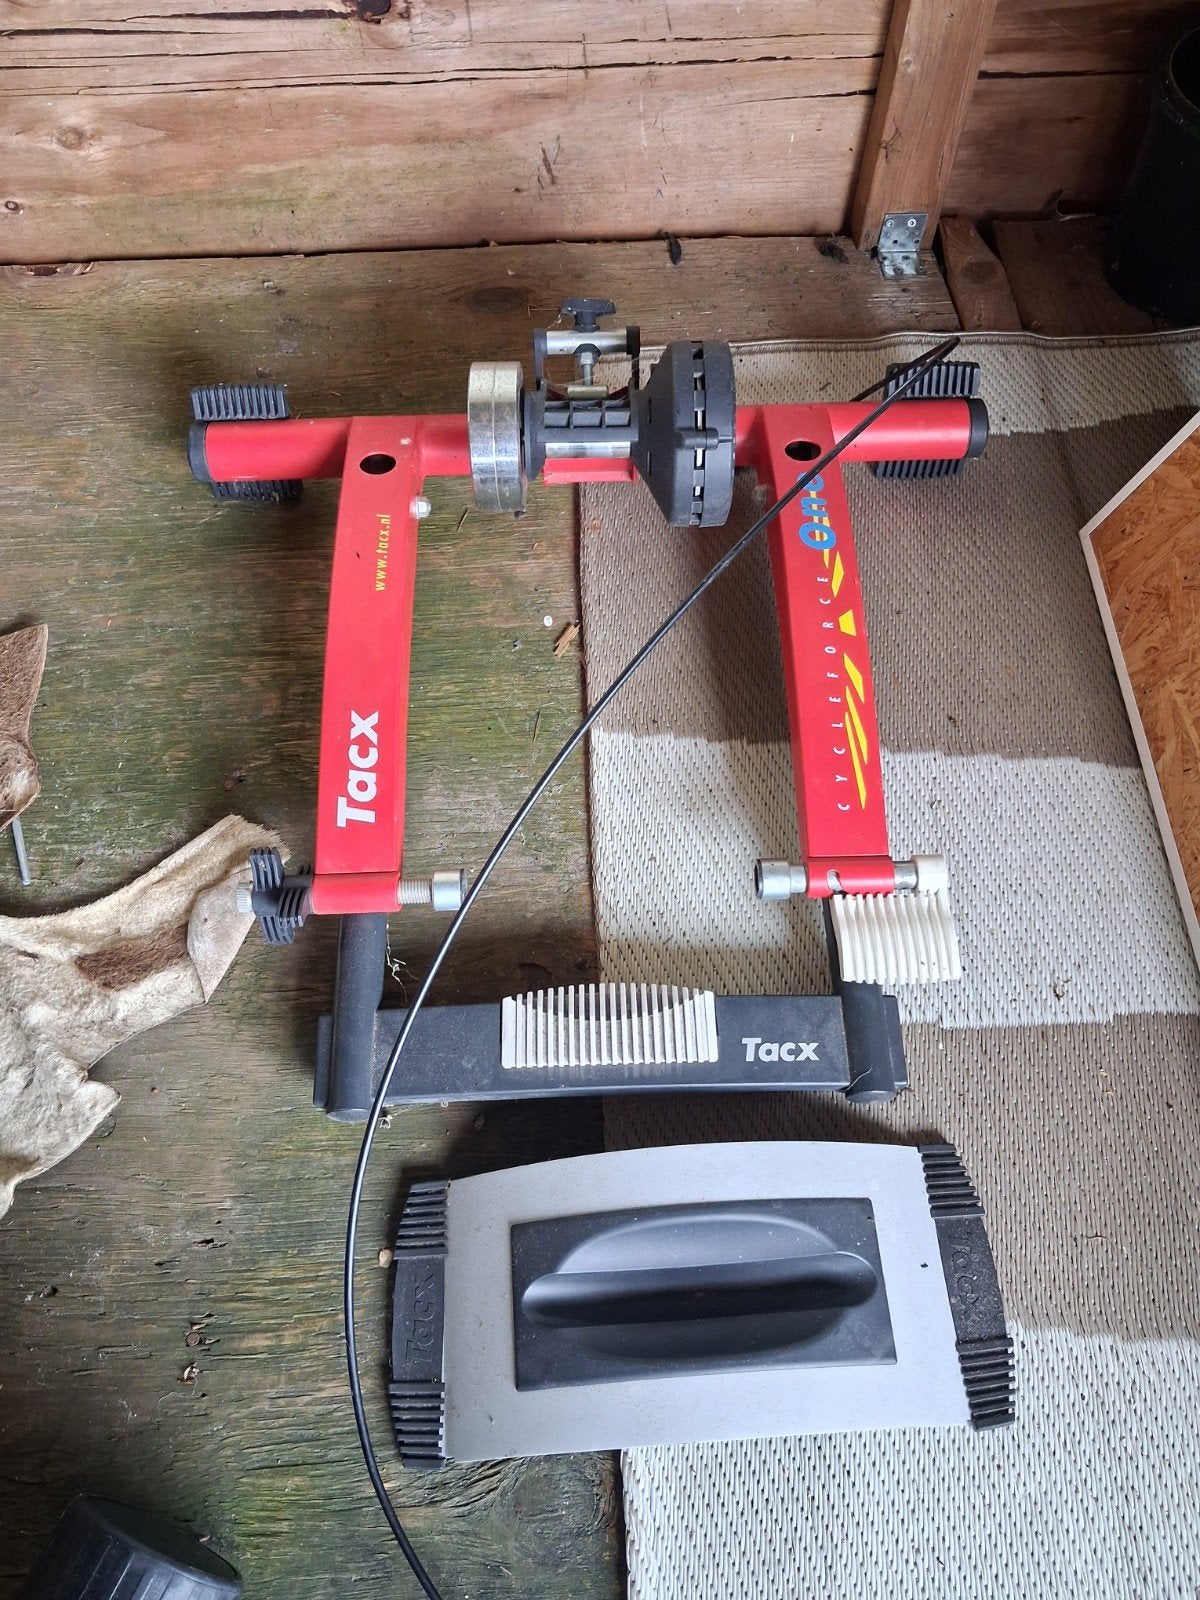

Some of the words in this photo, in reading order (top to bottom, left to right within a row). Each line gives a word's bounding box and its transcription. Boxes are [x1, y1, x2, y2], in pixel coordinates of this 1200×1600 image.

[375, 514, 391, 591] www.tacx.nl
[336, 709, 379, 828] Tacx
[741, 1037, 820, 1062] Tacx
[405, 1269, 435, 1363] Tacx
